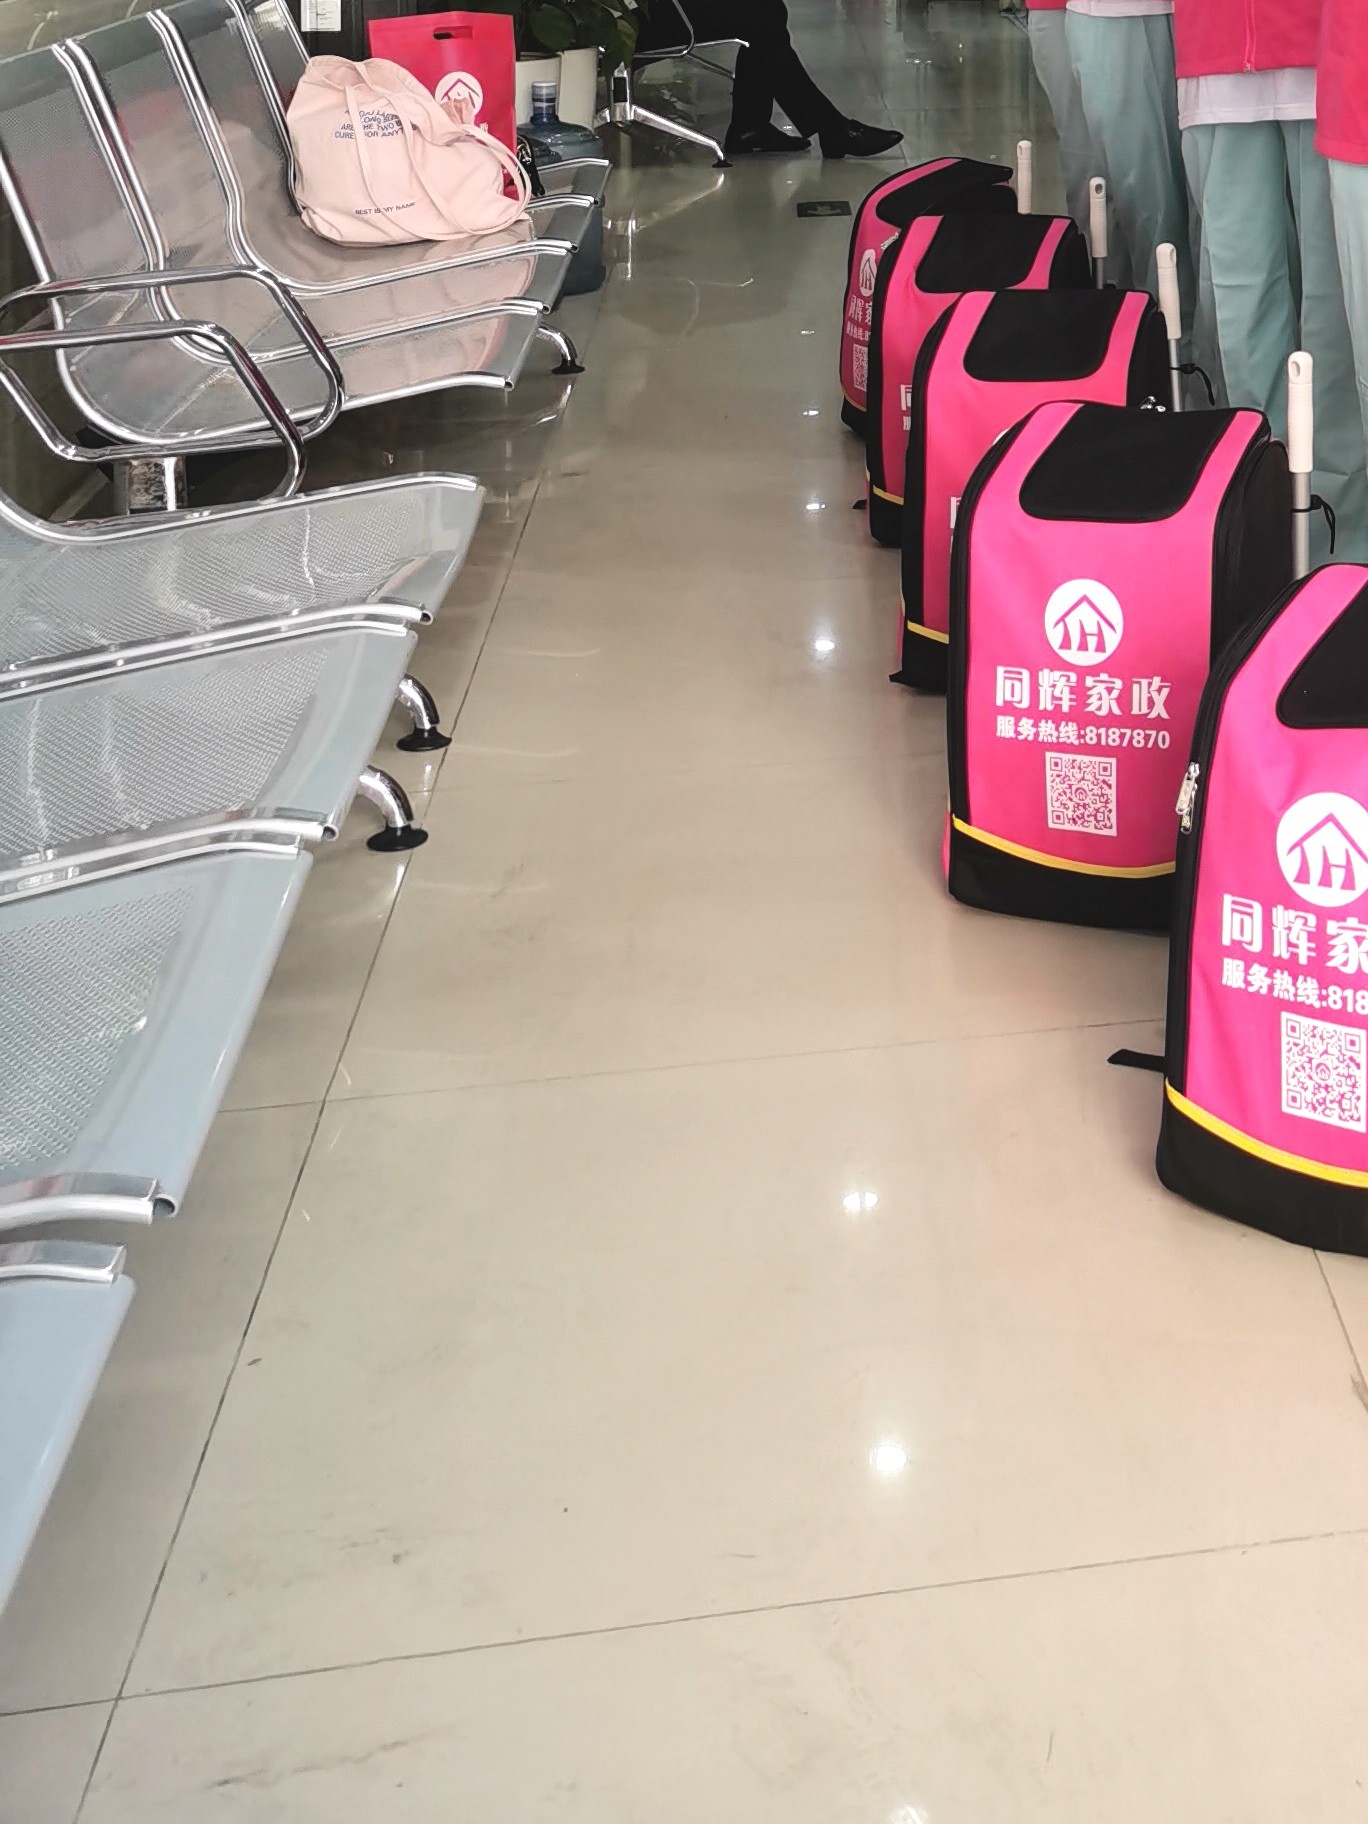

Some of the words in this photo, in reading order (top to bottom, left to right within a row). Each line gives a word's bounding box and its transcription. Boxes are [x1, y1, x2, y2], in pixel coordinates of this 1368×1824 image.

[995, 665, 1171, 720] 同辉家政
[996, 715, 1170, 750] 服务热线:8187870
